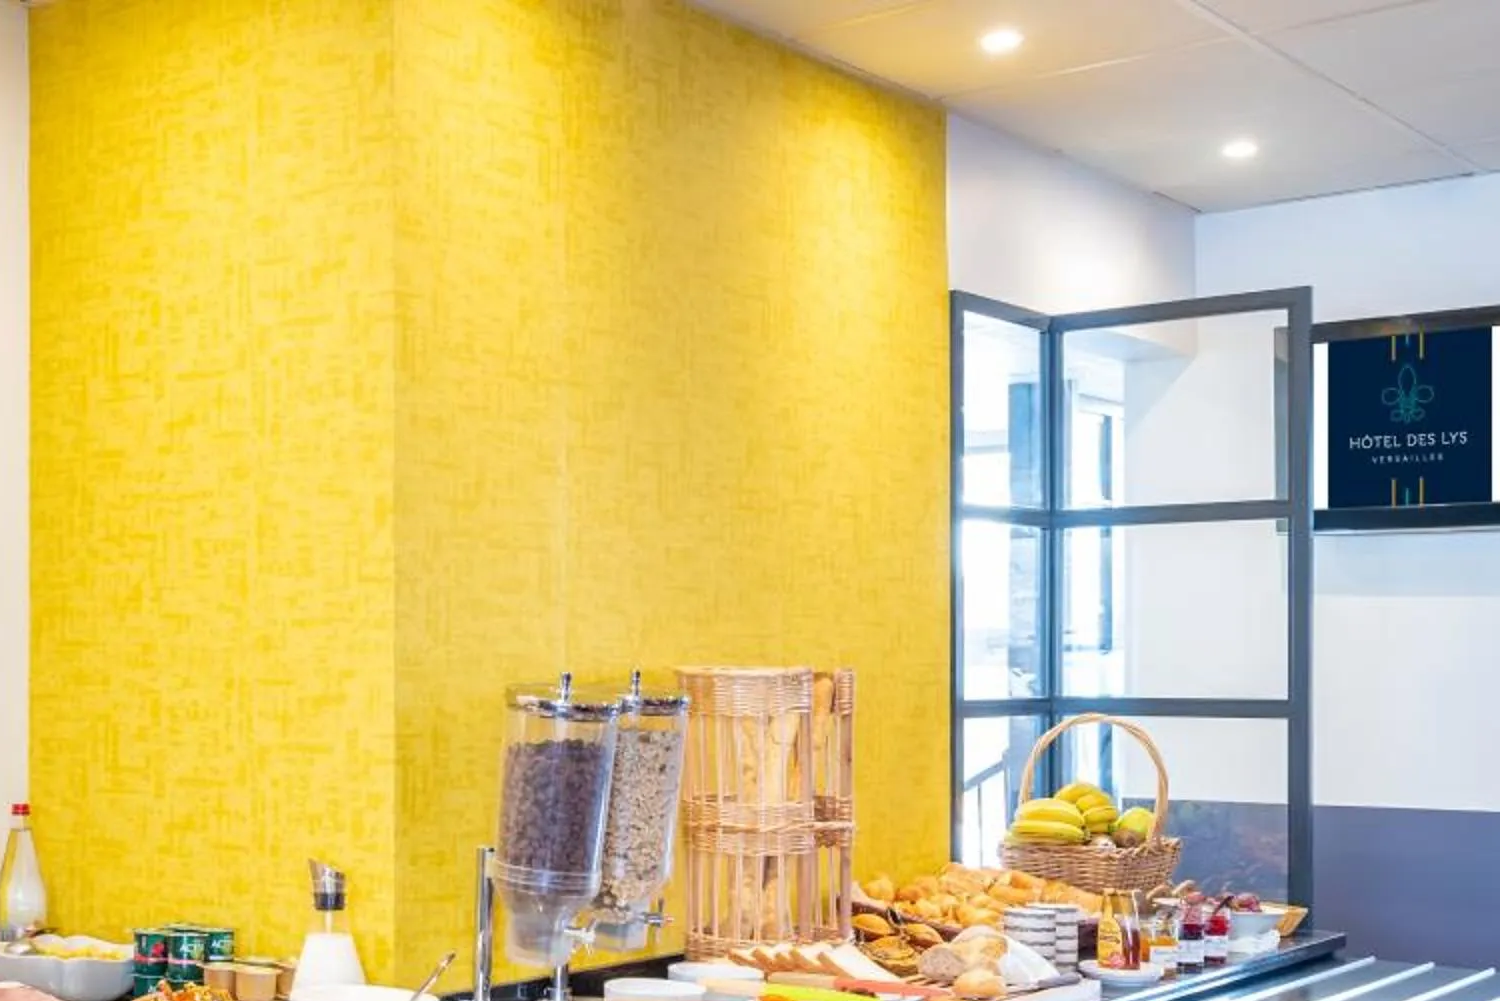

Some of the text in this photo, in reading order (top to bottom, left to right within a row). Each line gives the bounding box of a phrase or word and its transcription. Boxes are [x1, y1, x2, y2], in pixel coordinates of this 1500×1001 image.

[1349, 430, 1468, 449] HÔTEL DES LYS
